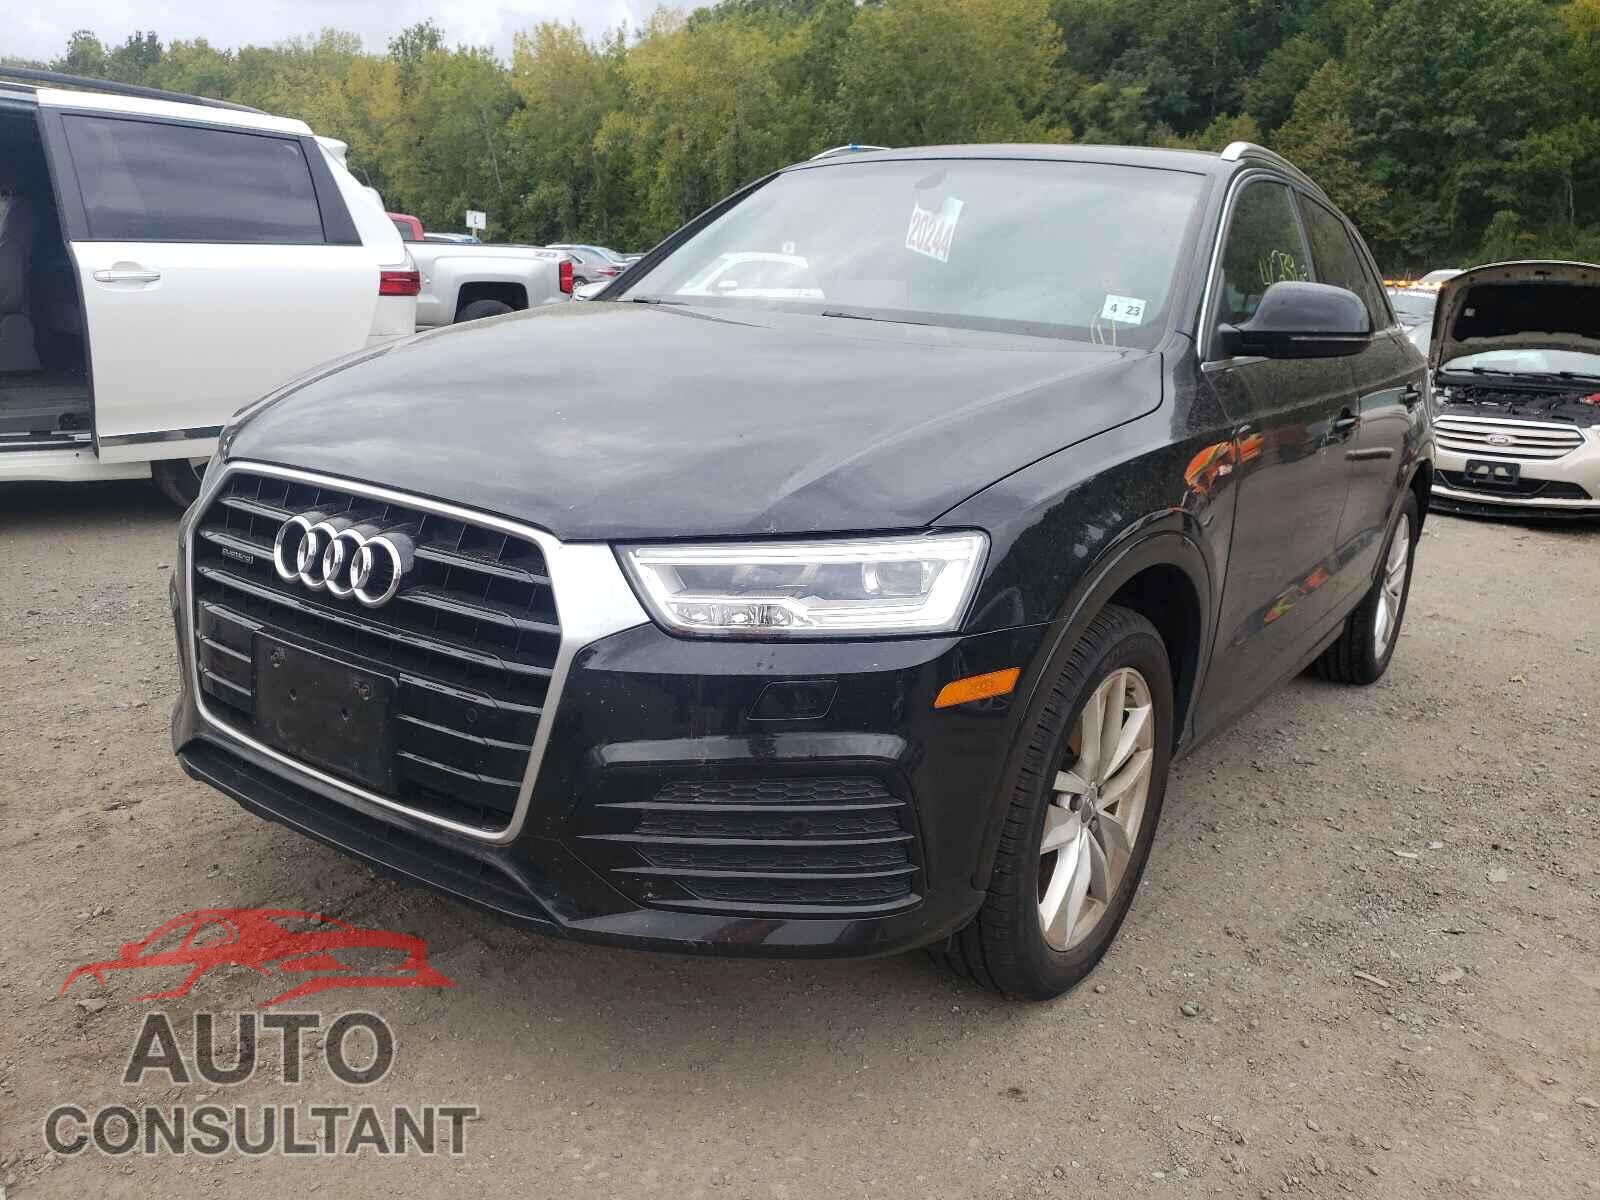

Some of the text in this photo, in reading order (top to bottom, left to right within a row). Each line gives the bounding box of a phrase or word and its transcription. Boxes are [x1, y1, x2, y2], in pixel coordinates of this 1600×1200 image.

[906, 211, 955, 258] 20244
[1110, 303, 1141, 316] 4 23
